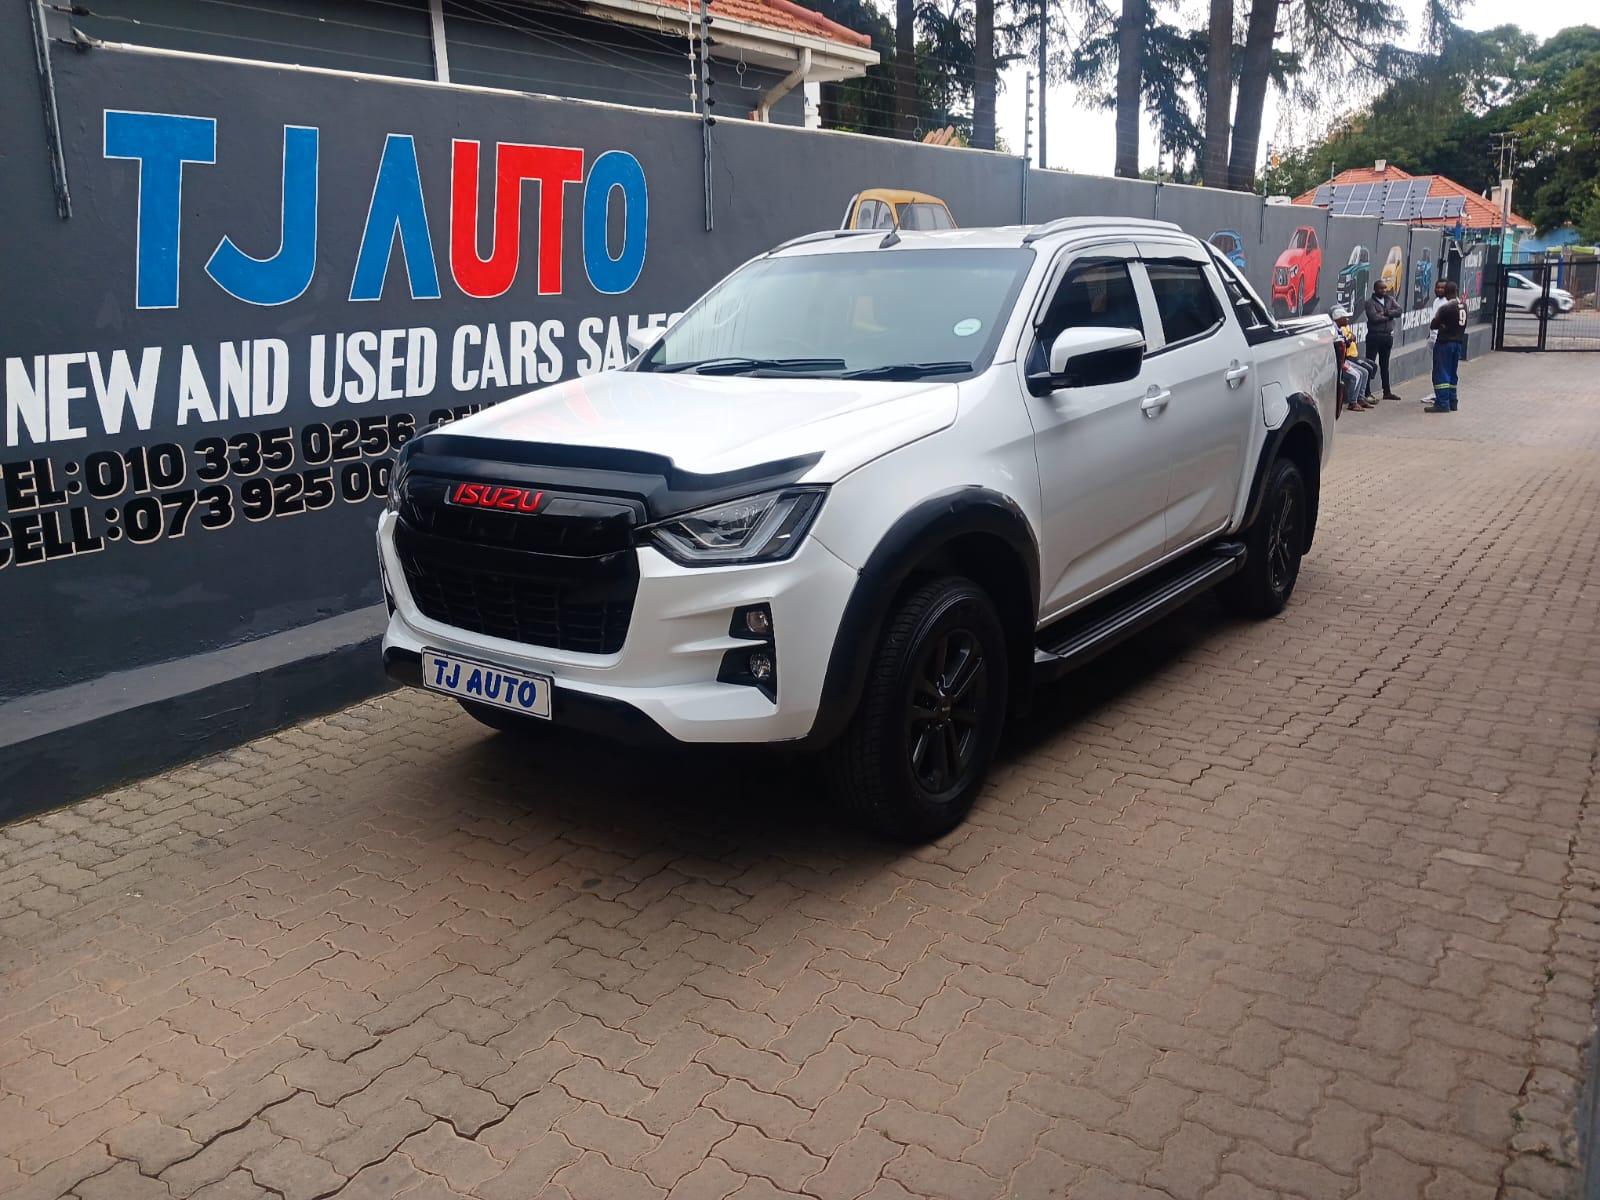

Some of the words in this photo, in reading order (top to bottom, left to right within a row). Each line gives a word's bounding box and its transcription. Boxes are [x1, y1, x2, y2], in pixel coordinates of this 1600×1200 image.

[103, 109, 319, 309] TJ
[348, 133, 648, 301] AUTO
[1458, 309, 1467, 327] 9
[6, 346, 162, 447] NEW
[177, 338, 289, 425] AND
[309, 327, 437, 408] USED
[451, 319, 564, 391] CARS
[0, 443, 187, 513] EL:010
[194, 427, 295, 483] 335
[301, 413, 416, 466] 0256
[241, 467, 336, 522] 925
[453, 482, 544, 514] ISUZU
[433, 658, 461, 689] TJ
[466, 668, 537, 708] AUTO
